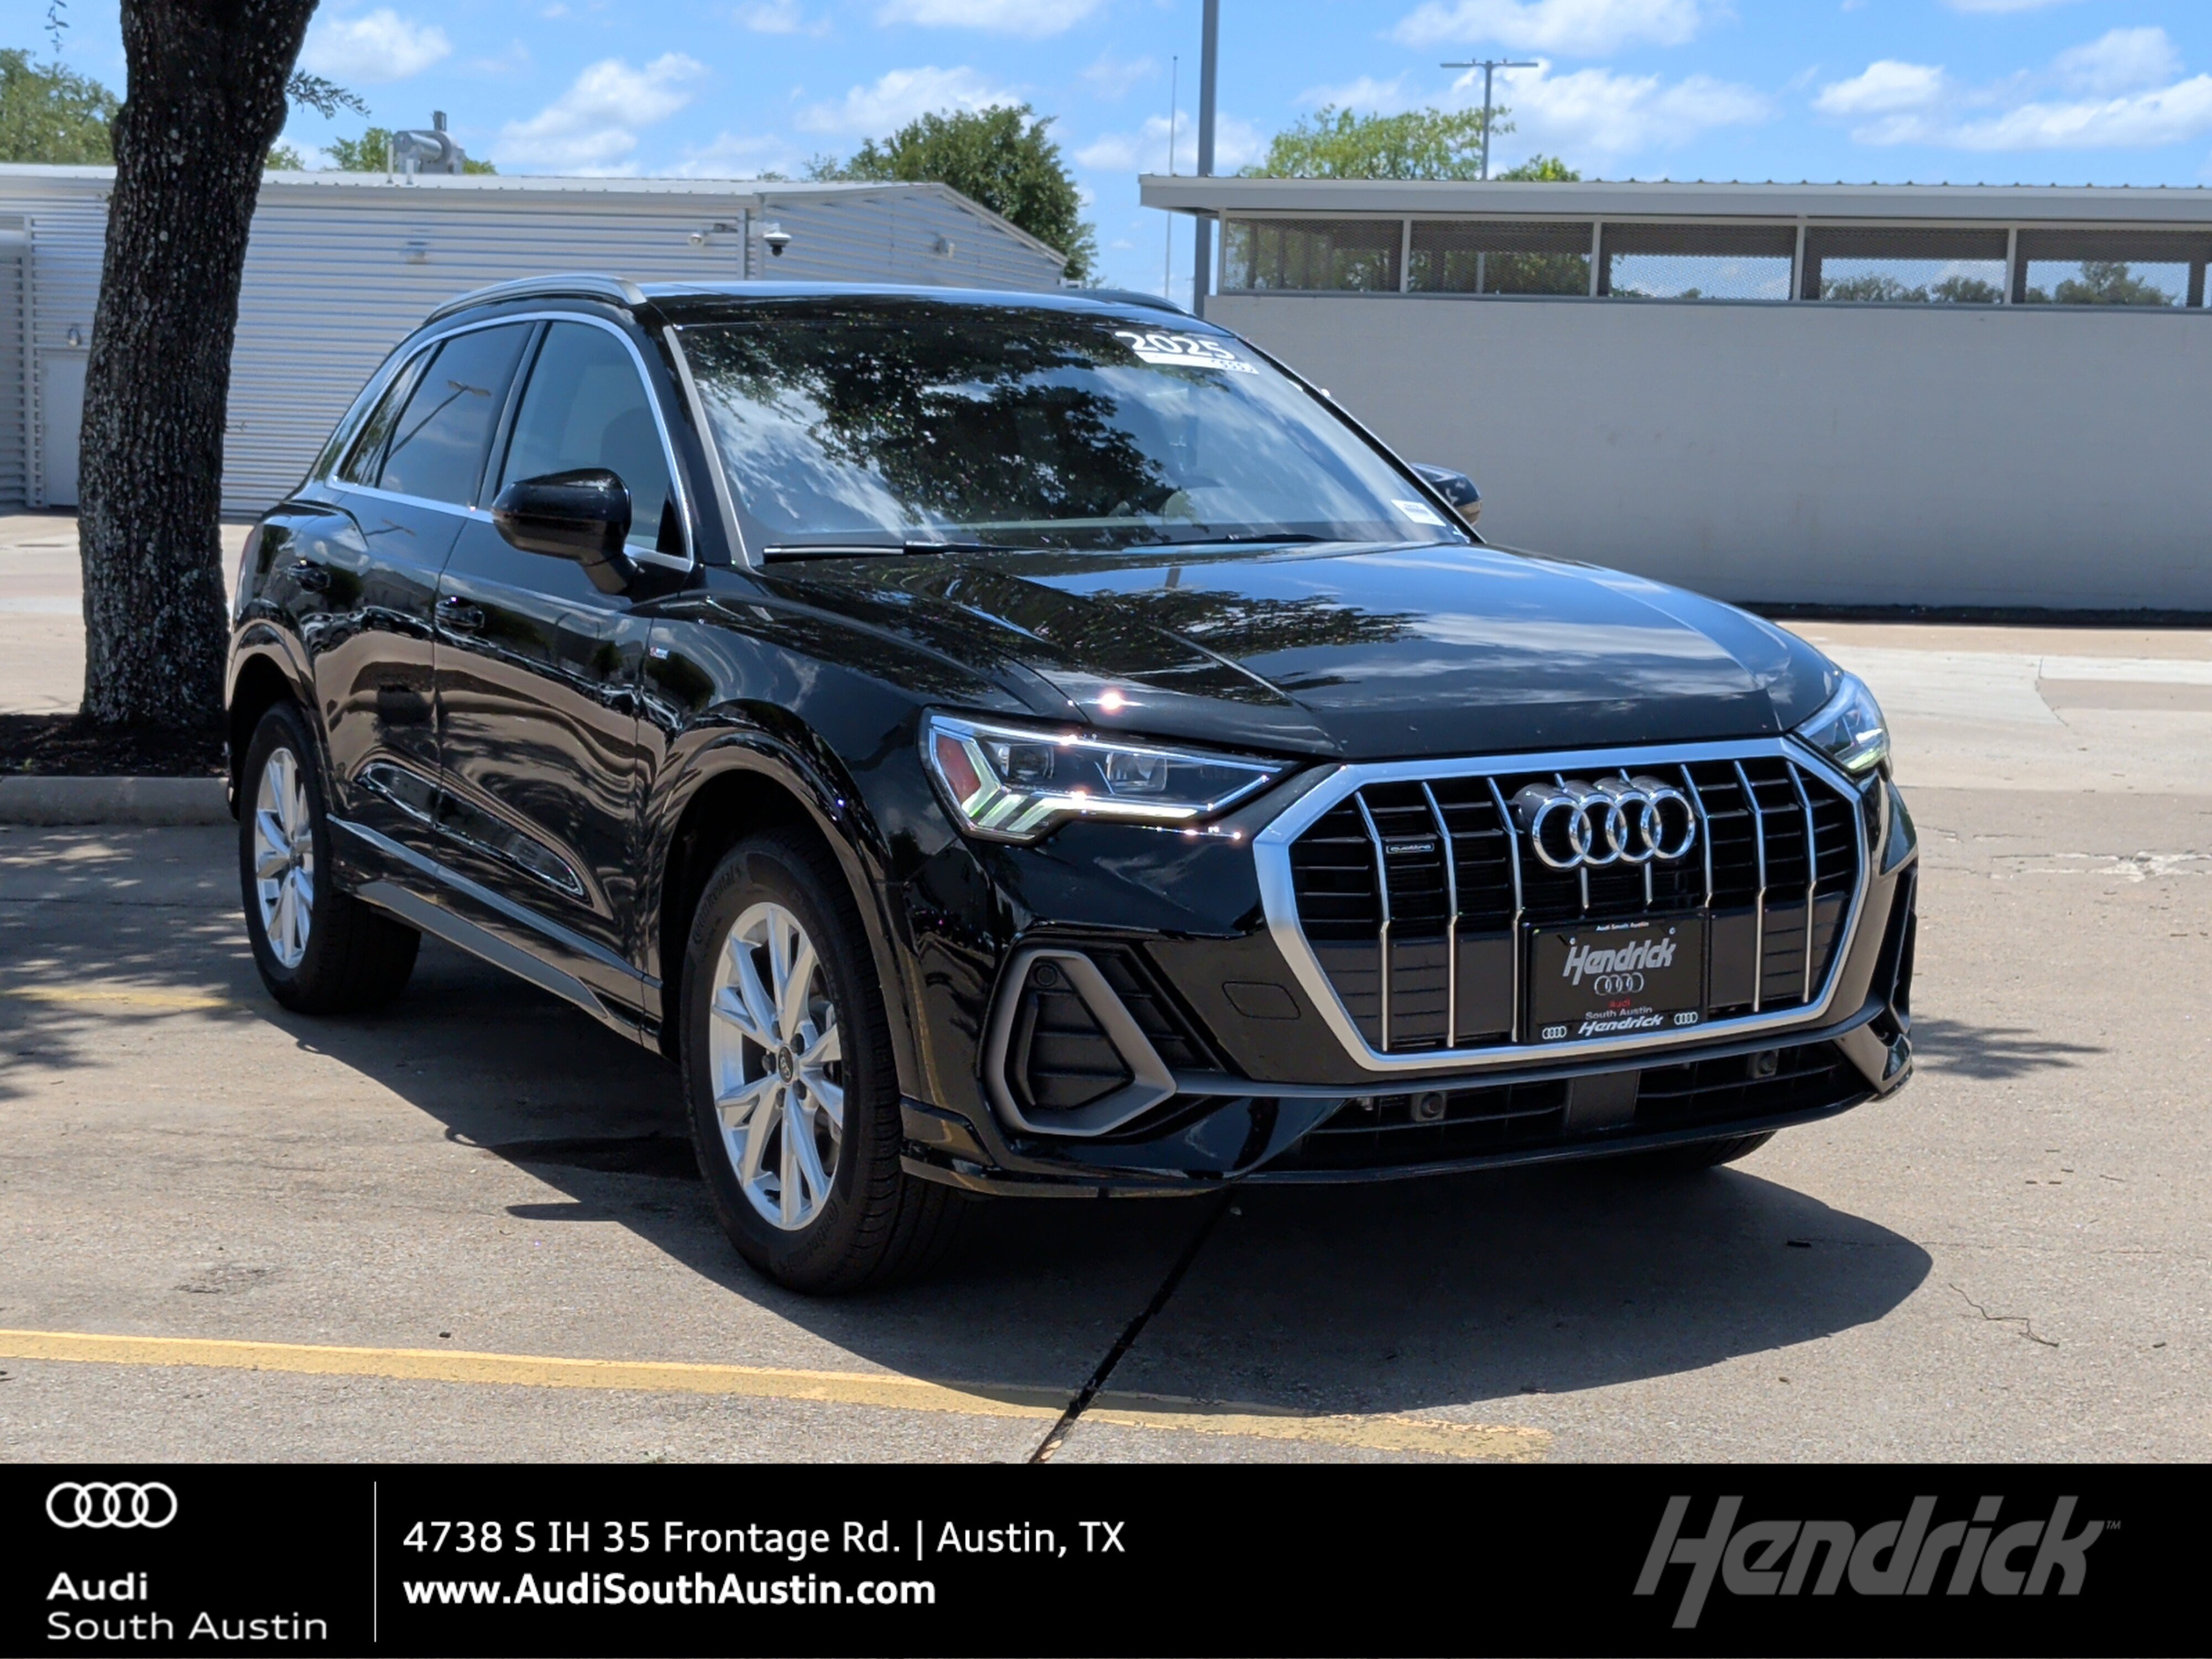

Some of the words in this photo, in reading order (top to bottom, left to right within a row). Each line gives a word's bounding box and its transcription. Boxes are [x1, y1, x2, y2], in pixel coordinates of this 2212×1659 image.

[1115, 332, 1235, 359] 2025
[1563, 938, 1676, 985] Hendrick
[1585, 1009, 1616, 1020] South
[1619, 1006, 1653, 1016] Austin
[1608, 999, 1631, 1008] Audi
[1578, 1014, 1663, 1036] Hendrick
